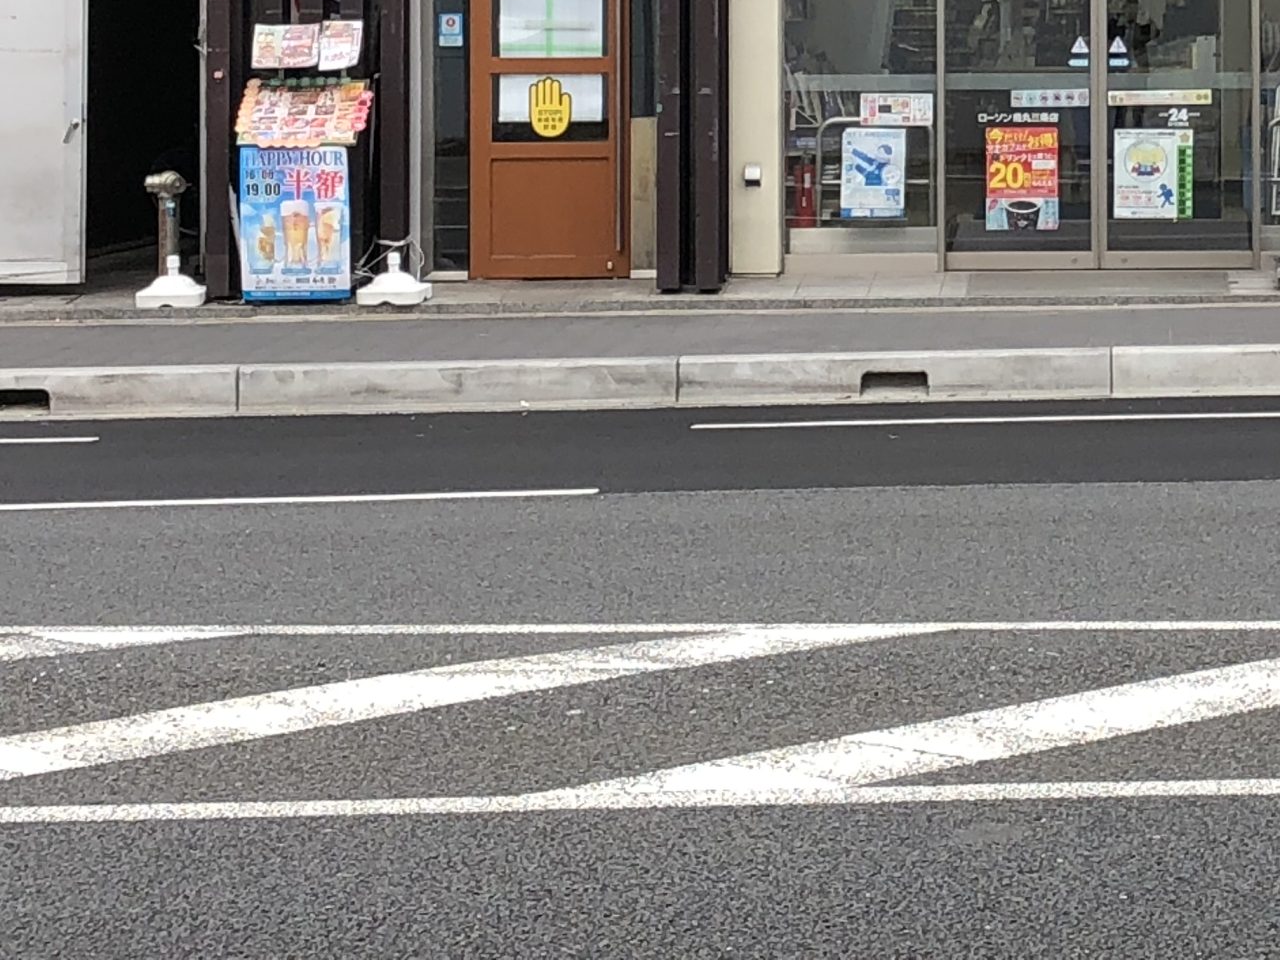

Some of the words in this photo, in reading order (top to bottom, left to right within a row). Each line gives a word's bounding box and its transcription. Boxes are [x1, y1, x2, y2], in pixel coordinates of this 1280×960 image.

[1168, 107, 1189, 121] 24
[244, 150, 294, 167] HAPPY
[299, 150, 345, 167] HOUR
[284, 168, 345, 201] 半額
